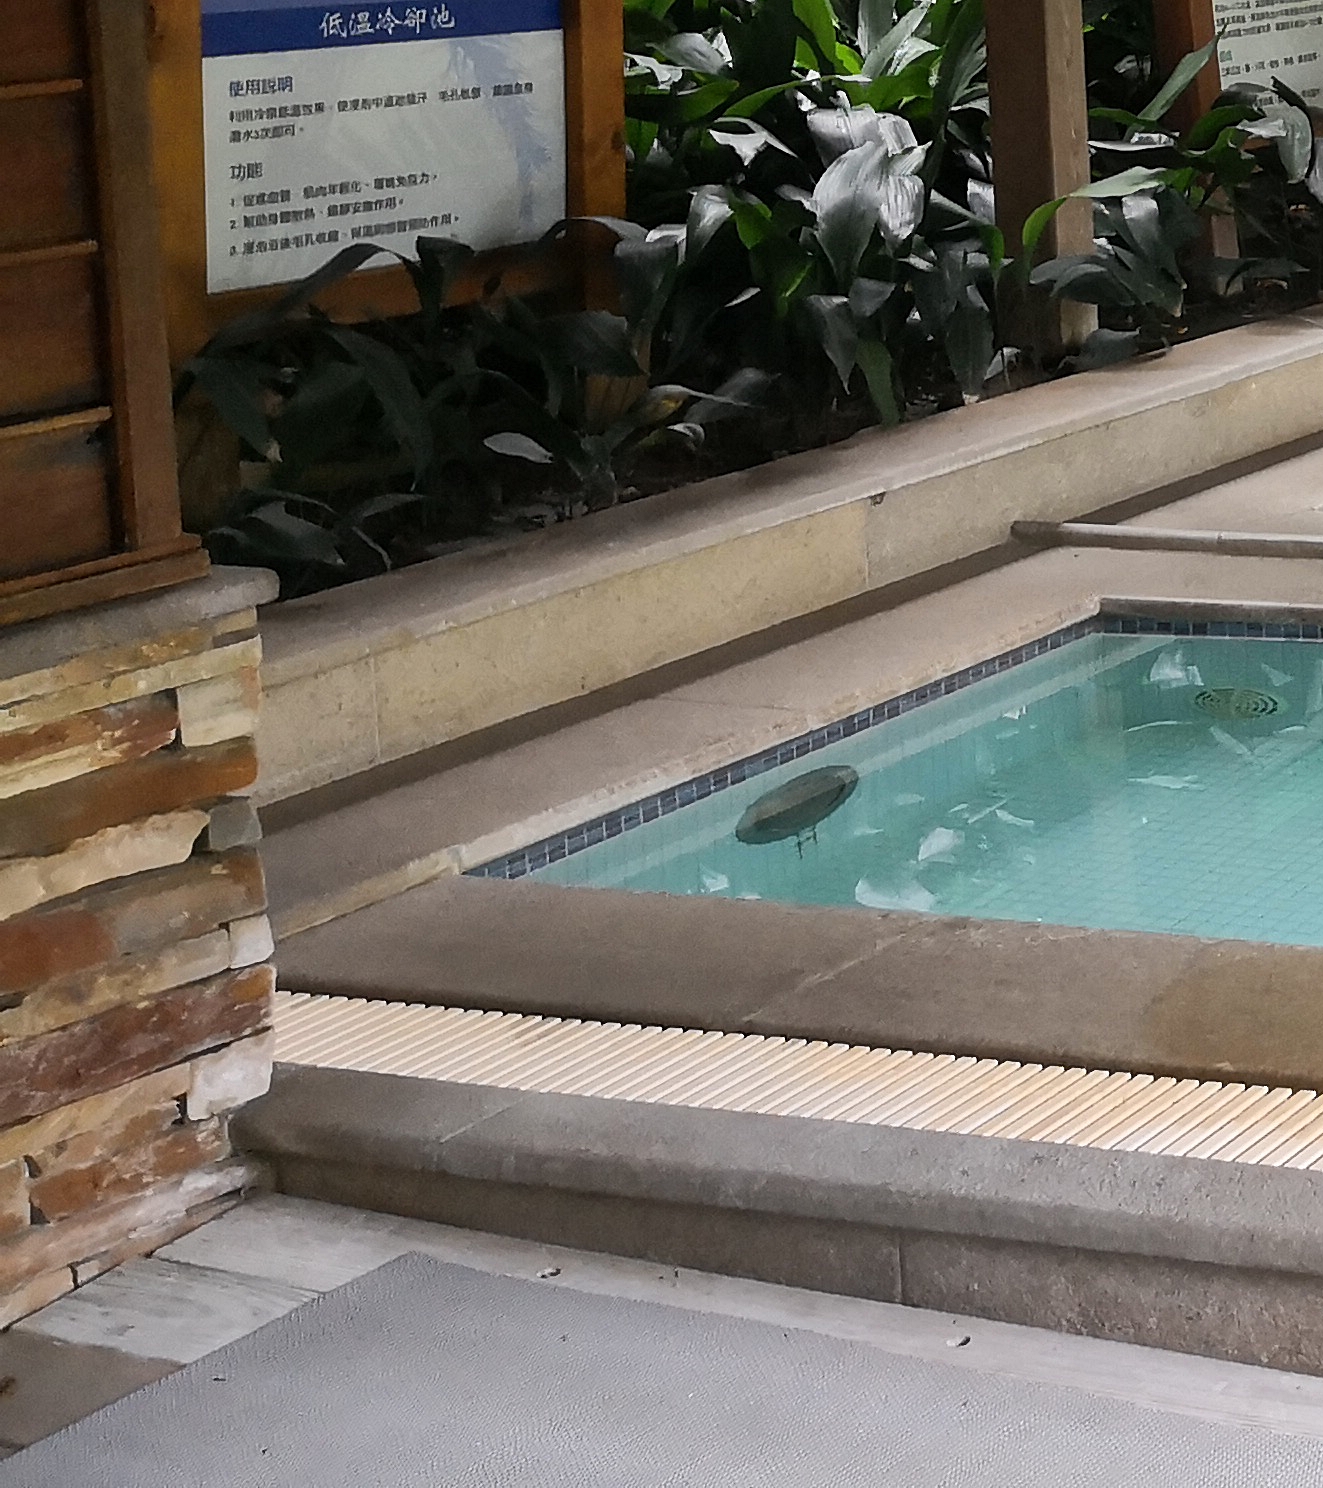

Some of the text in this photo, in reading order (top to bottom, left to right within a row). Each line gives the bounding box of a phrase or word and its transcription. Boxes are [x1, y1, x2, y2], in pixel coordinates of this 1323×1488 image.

[319, 3, 456, 38] 低溫冷卻池
